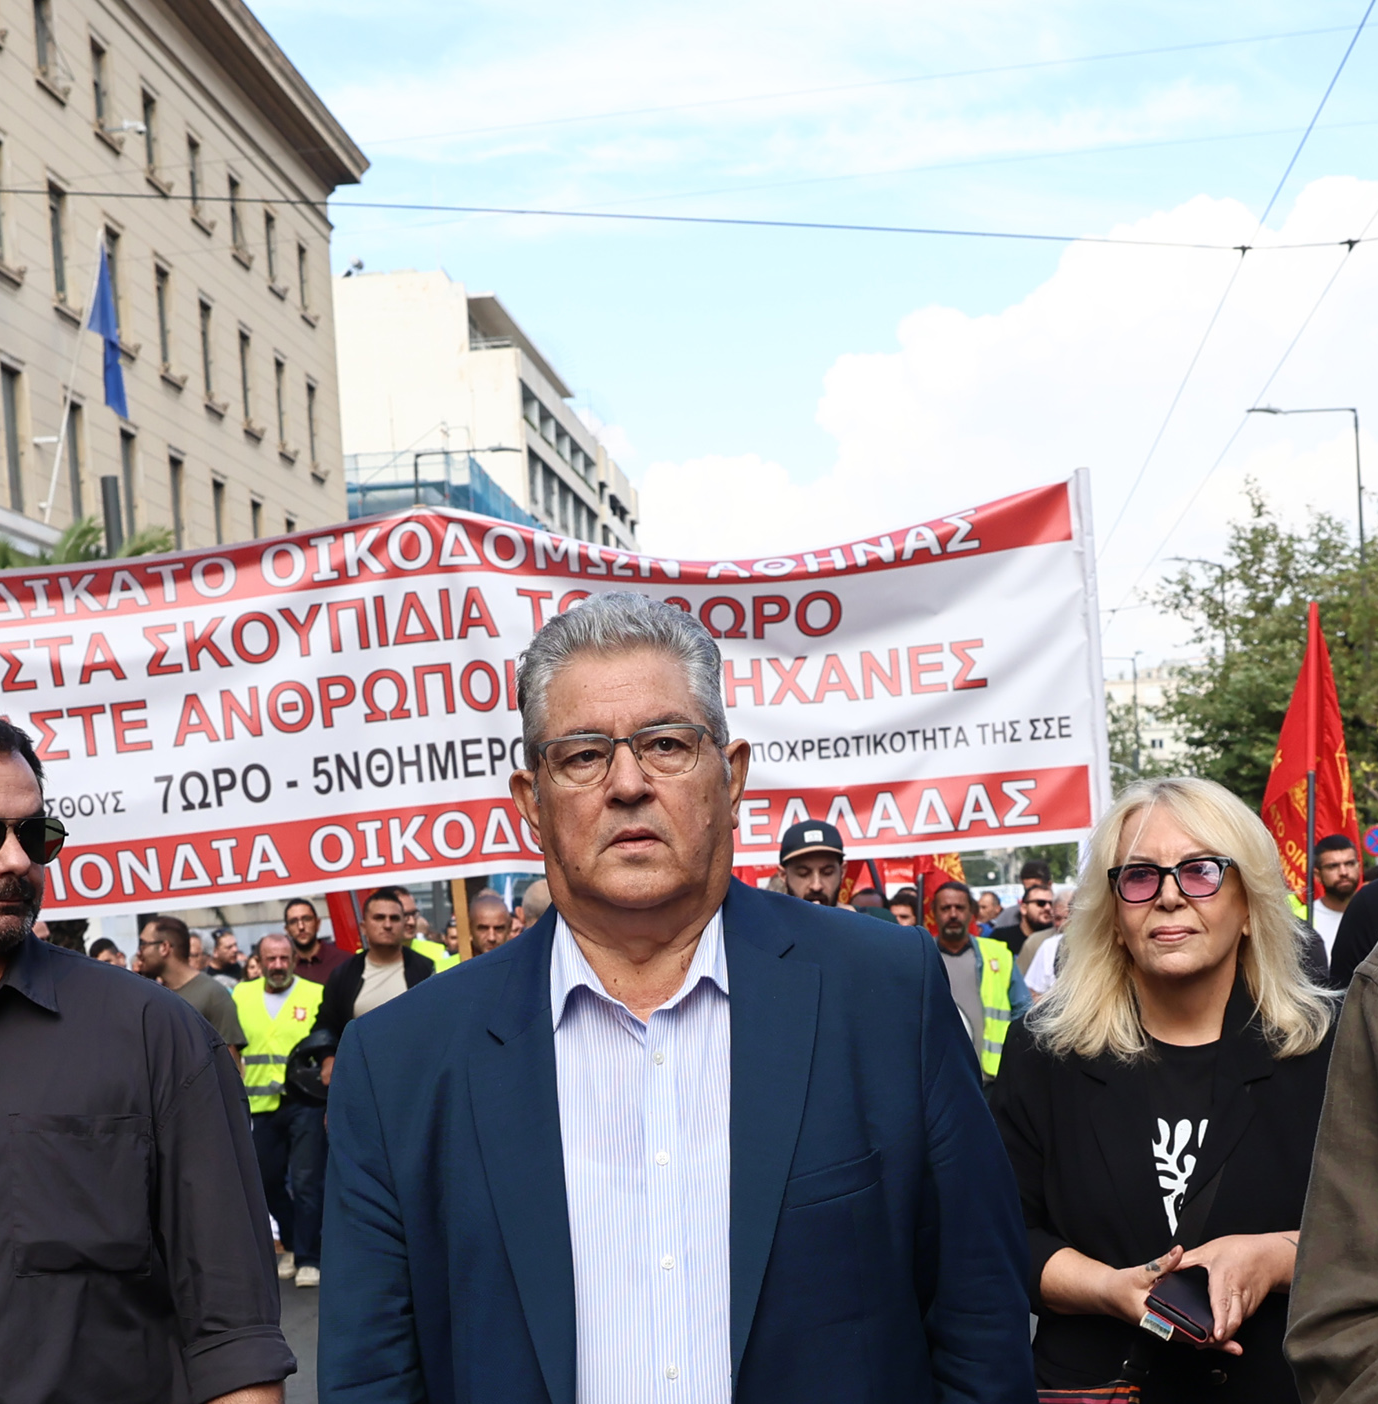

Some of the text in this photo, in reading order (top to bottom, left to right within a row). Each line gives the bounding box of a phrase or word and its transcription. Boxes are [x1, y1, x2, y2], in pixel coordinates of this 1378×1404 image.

[259, 520, 682, 580] ΟΙΚΟΔΟΜΩΝ
[707, 510, 981, 580] ΑΘΗΝΑΣ
[143, 586, 500, 677] ΣΚΟΥΠΙΔΙΑ
[725, 638, 988, 708] ΗΧΑΝΕΣ
[45, 790, 126, 819] ΣΘΟΥΣ
[154, 762, 272, 815] 7ΩΡΟ
[751, 726, 970, 763] ΠΟΧΡΕΩΤΙΚΟΤΗΤΑ
[976, 720, 1022, 742] ΤΗΣ
[1029, 715, 1072, 741] ΣΣΕ
